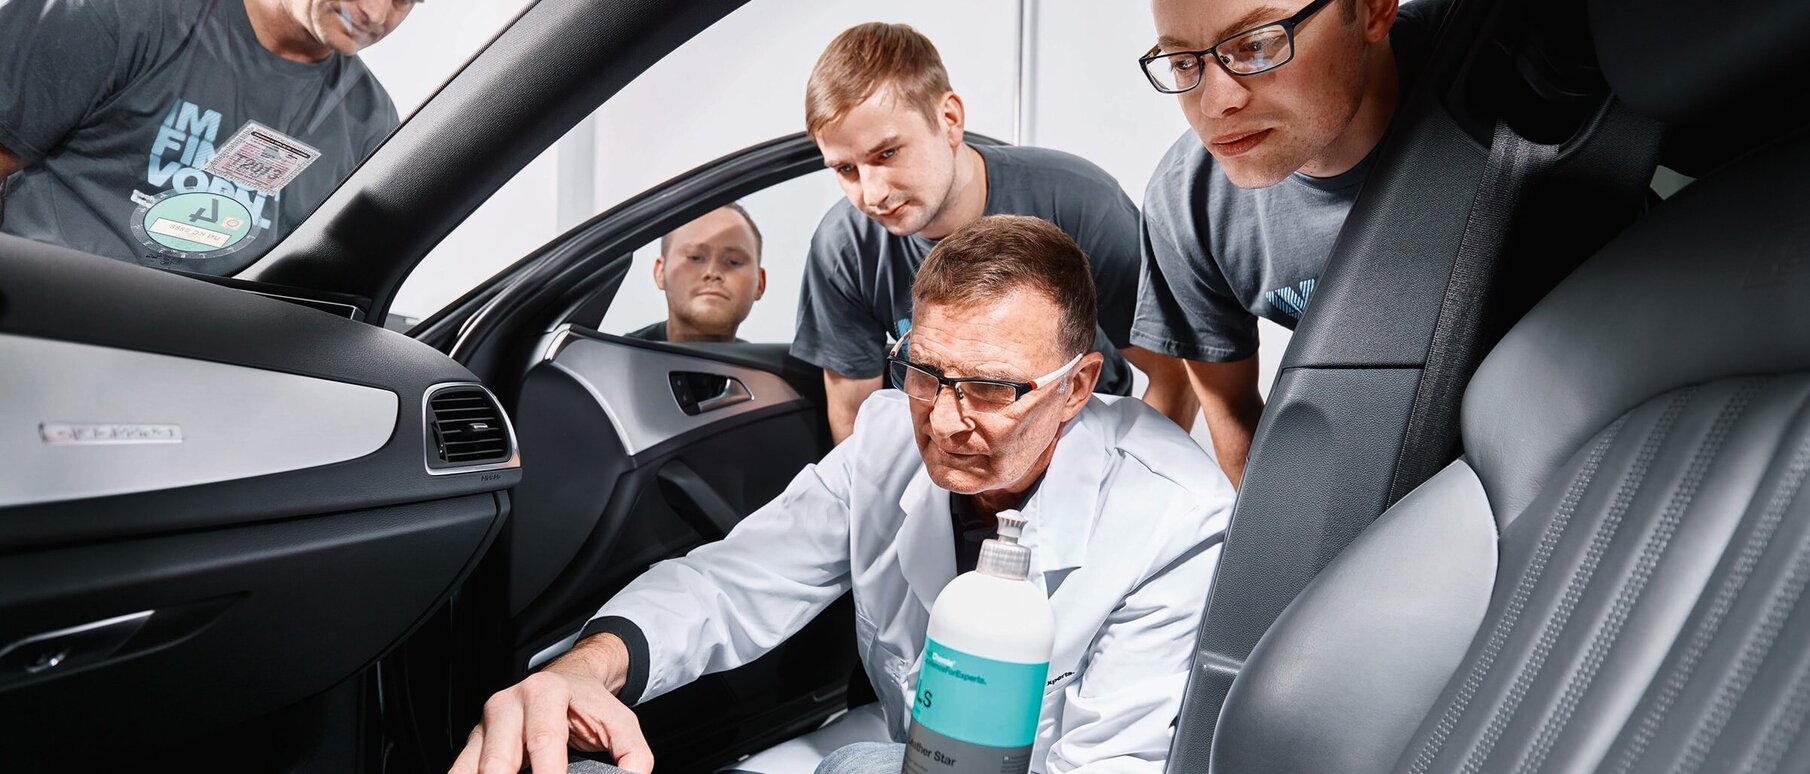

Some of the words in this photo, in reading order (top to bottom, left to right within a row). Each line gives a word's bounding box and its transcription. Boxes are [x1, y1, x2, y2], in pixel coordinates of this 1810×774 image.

[163, 97, 222, 142] IM
[150, 125, 216, 168] FIN
[1046, 671, 1076, 687] xperts.
[933, 750, 957, 767] Star
